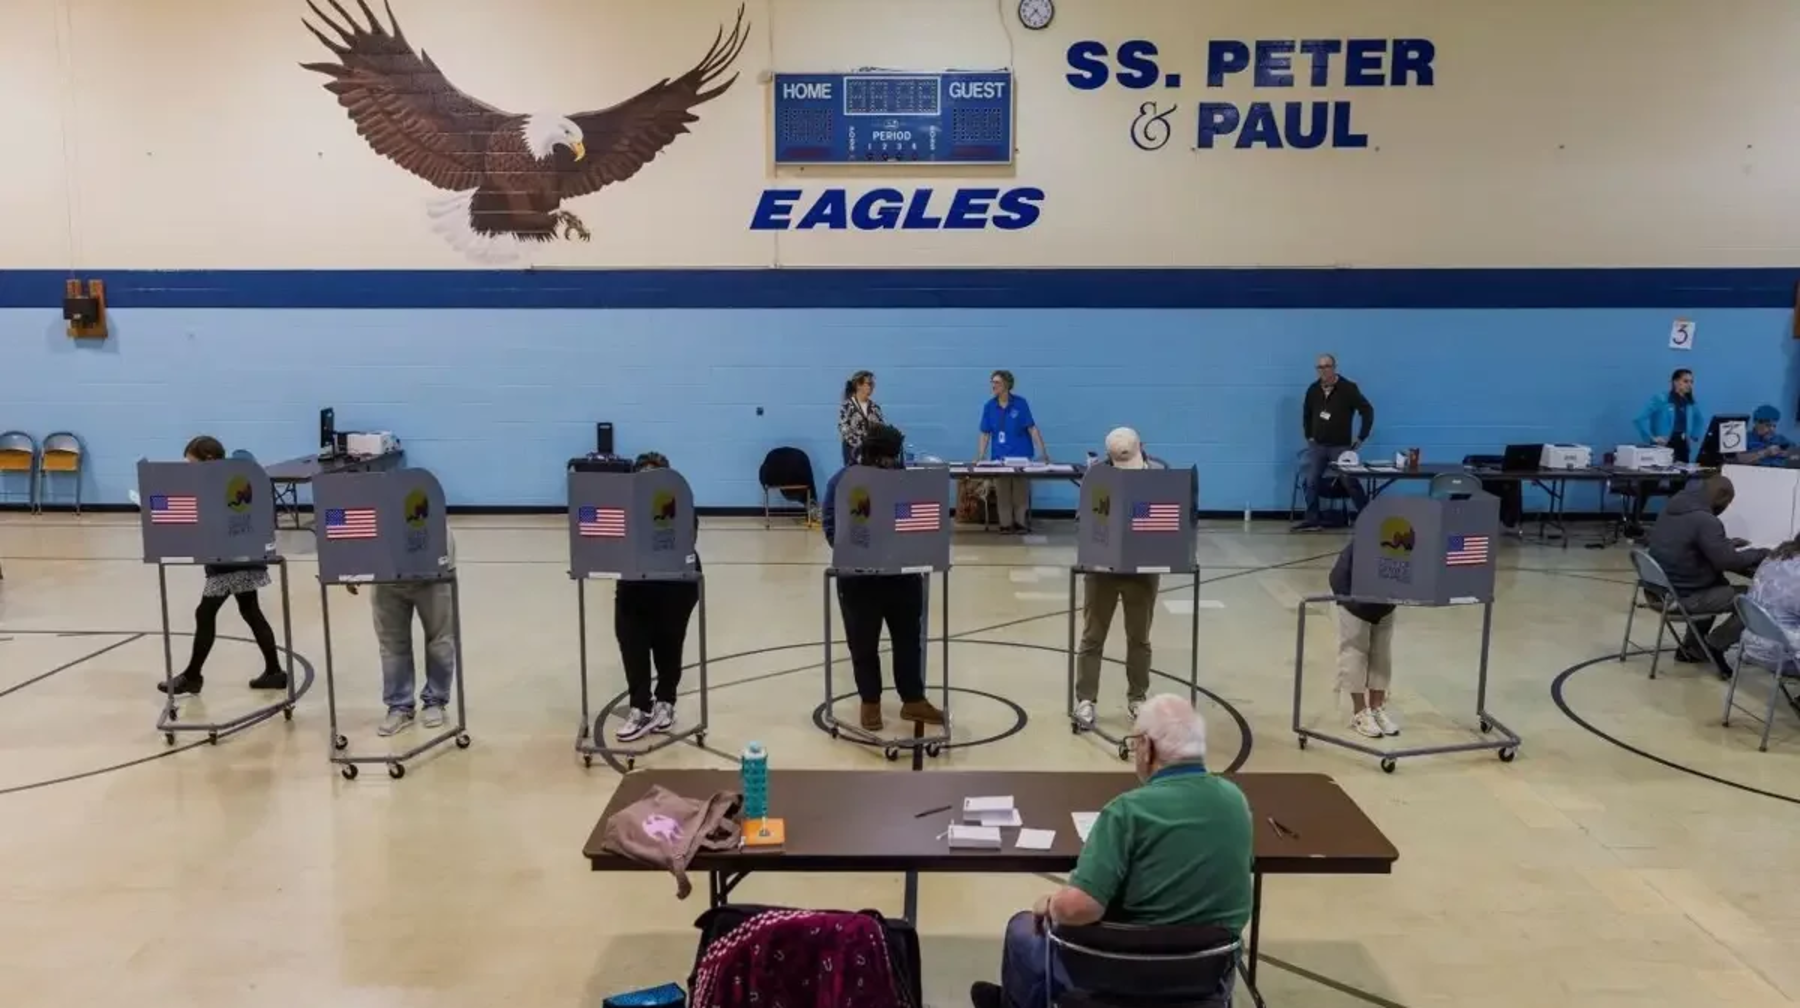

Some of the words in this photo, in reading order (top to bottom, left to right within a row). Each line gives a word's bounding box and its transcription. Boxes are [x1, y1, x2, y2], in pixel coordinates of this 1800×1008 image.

[1065, 40, 1181, 90] SS.
[1206, 38, 1436, 88] PETER
[783, 83, 832, 99] HOME
[950, 82, 1006, 99] GUEST
[872, 131, 912, 141] PERIOD
[1130, 101, 1177, 151] &
[1197, 101, 1368, 149] PAUL
[749, 187, 1046, 230] EAGLES
[1672, 324, 1689, 345] 3
[1722, 422, 1741, 449] 3
